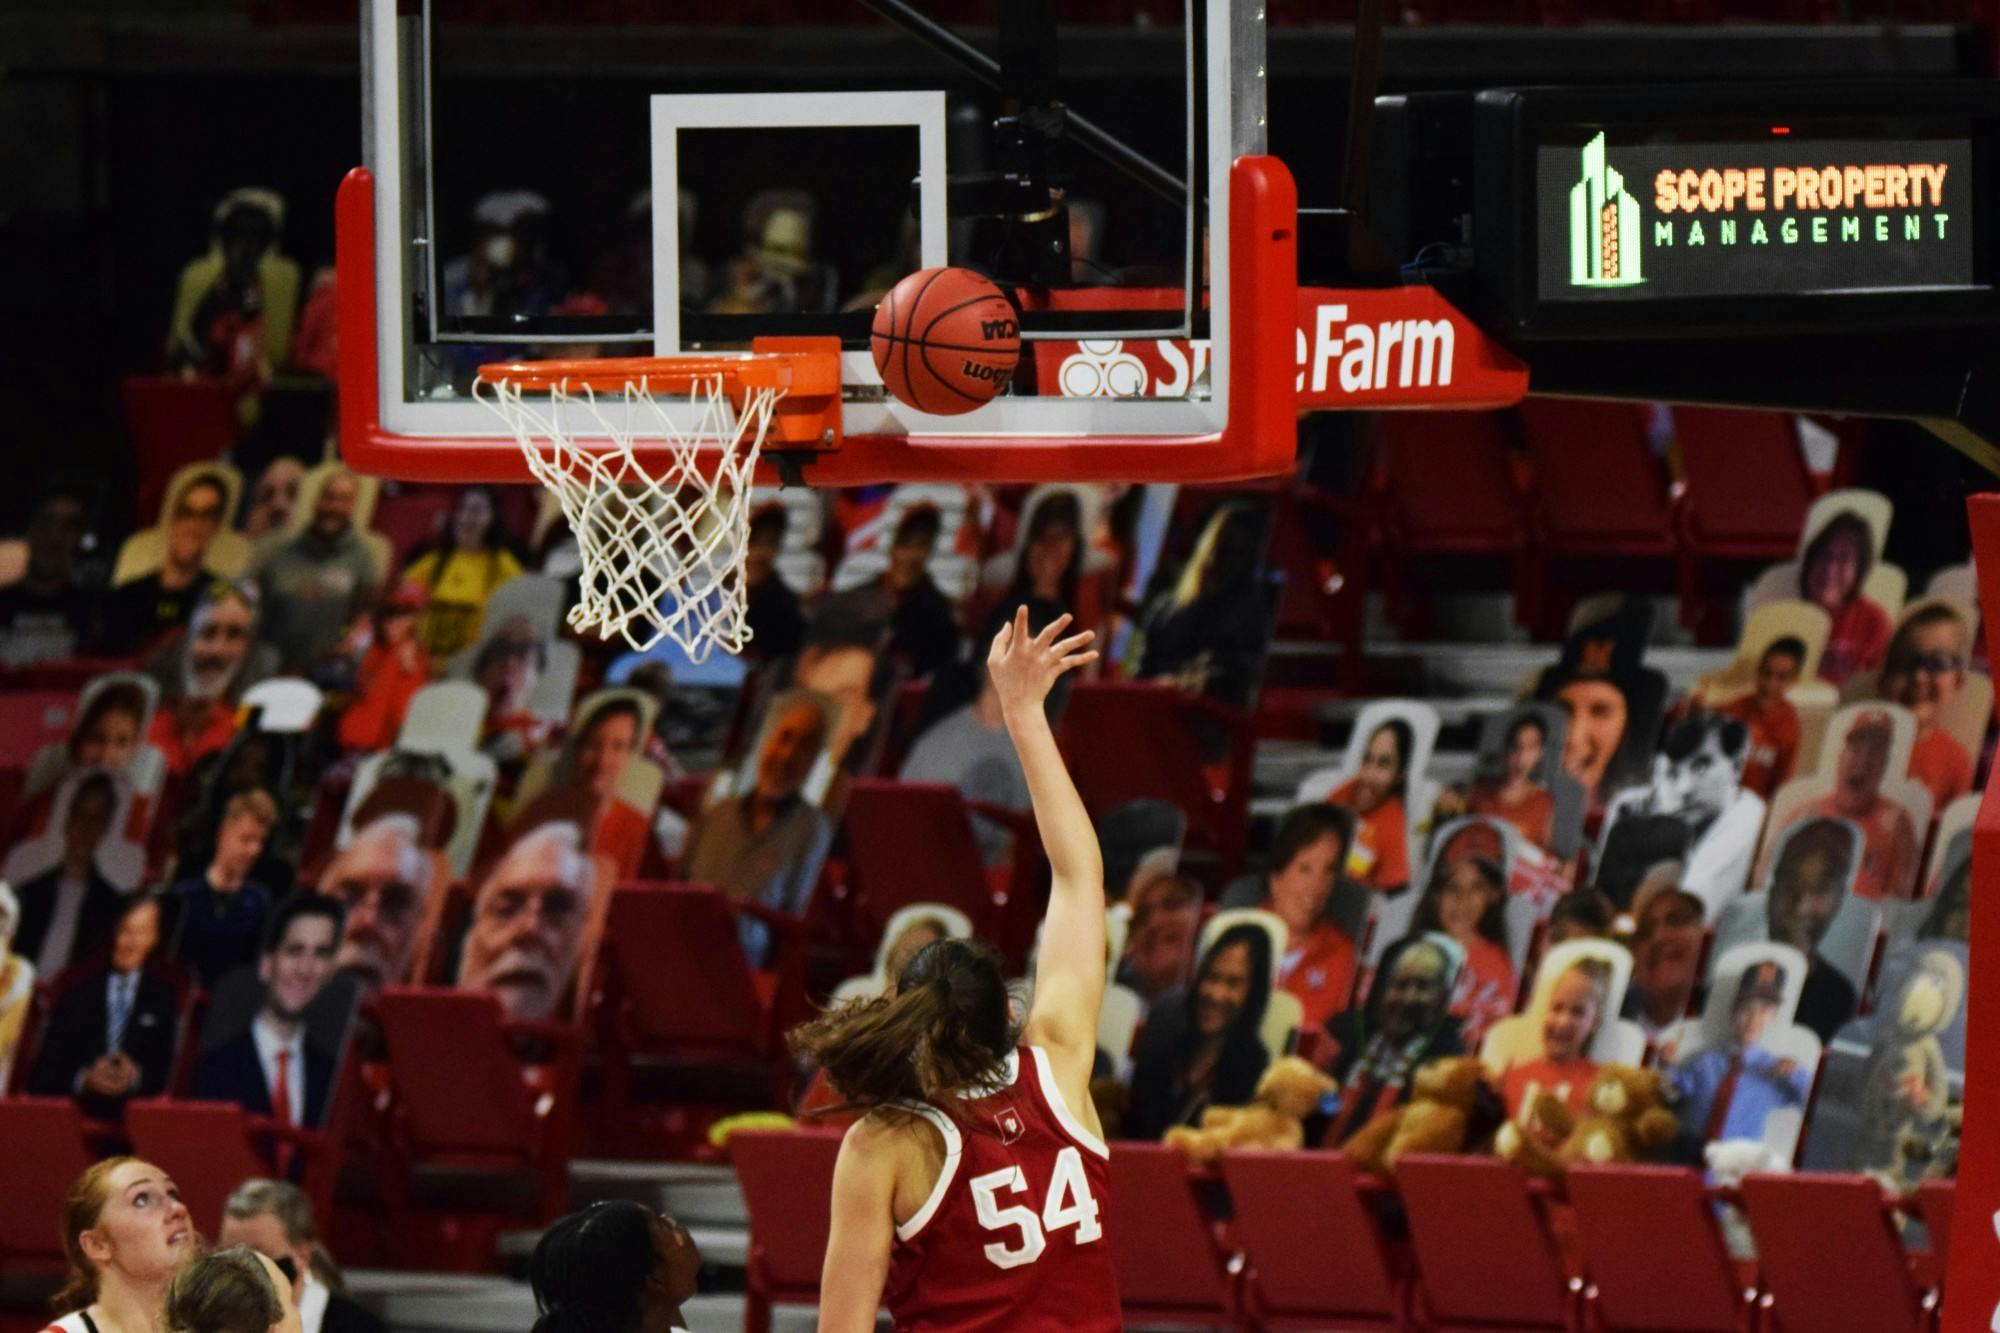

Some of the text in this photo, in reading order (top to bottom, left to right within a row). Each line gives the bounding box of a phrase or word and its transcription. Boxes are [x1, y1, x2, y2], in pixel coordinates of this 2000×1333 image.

[1654, 163, 1948, 213] SCOPE PROPERTY
[1654, 213, 1949, 246] MANAGEMENT
[981, 319, 1019, 341] CAA
[1311, 303, 1455, 393] Farm
[968, 1145, 1103, 1270] 54
